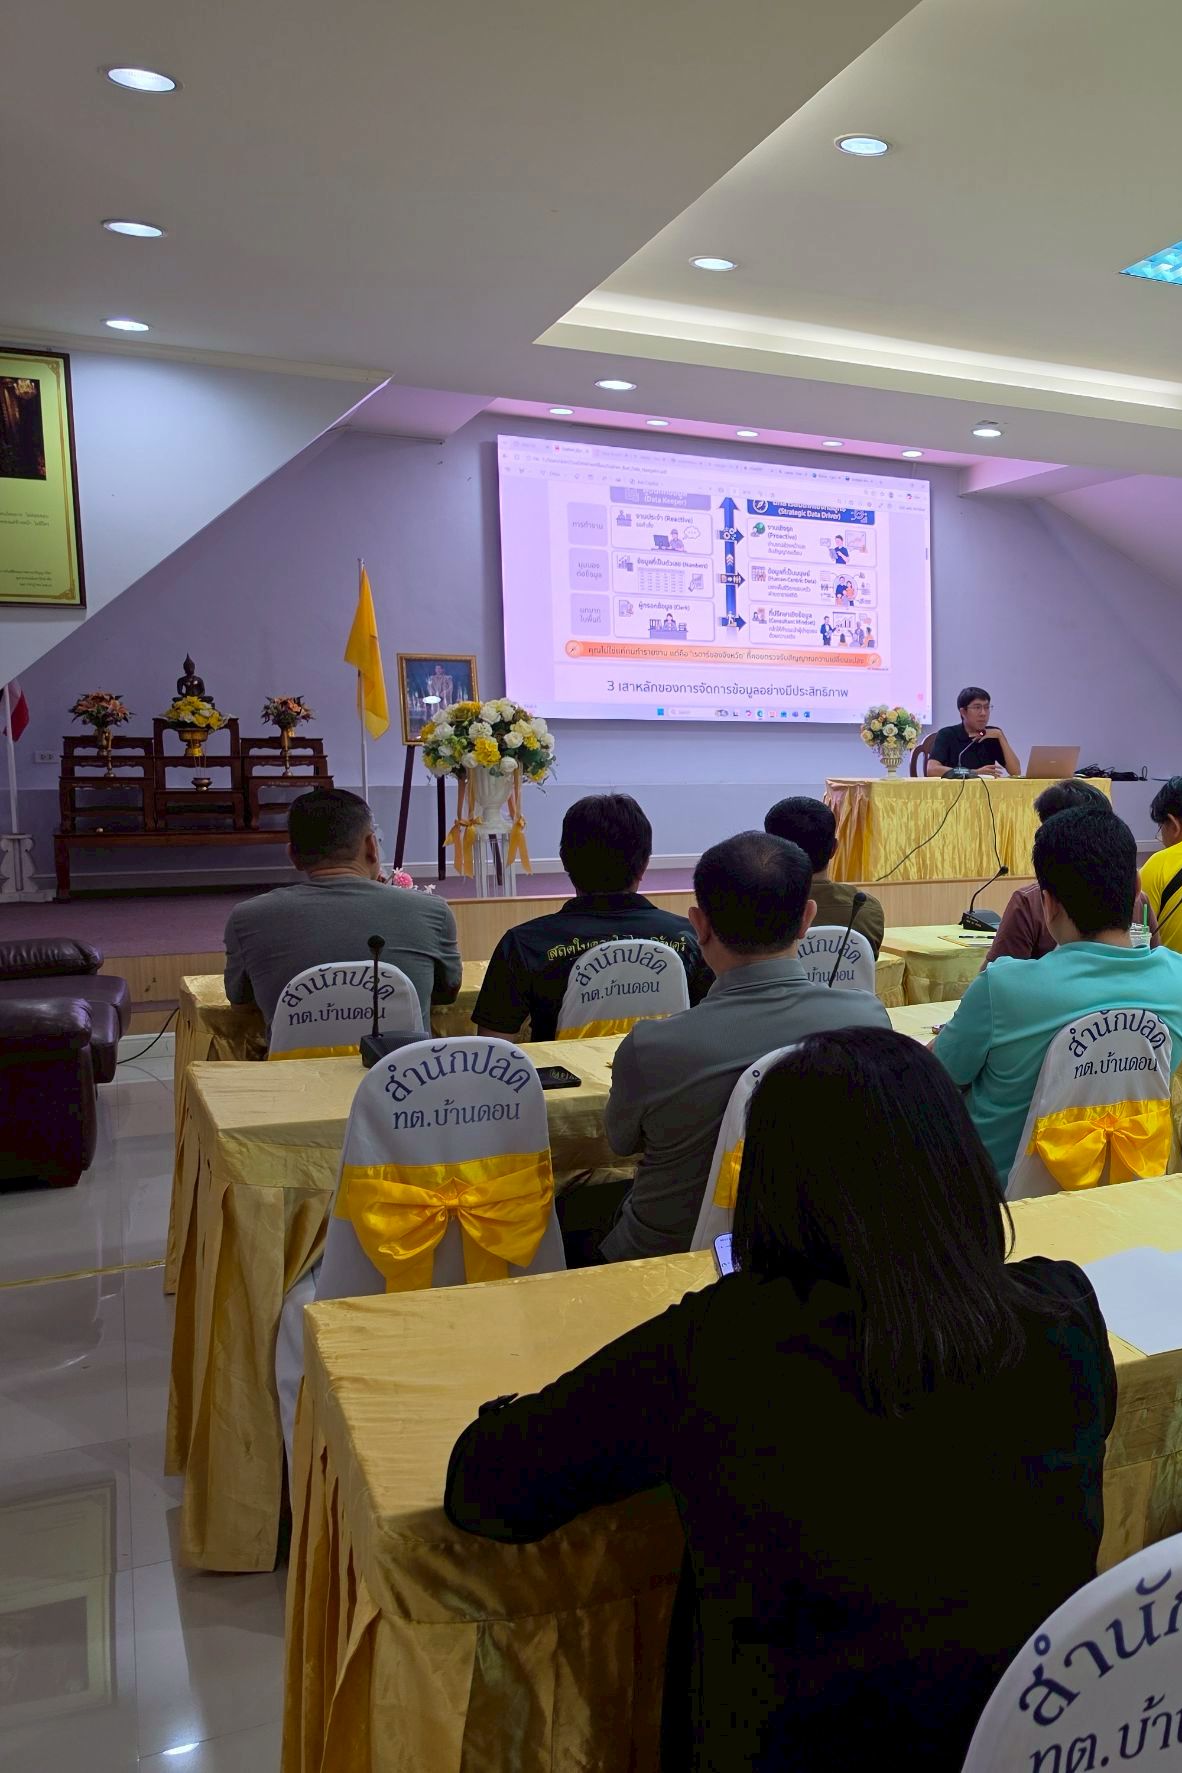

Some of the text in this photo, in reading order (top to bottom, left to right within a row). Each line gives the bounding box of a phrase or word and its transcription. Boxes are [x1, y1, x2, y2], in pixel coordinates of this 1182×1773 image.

[664, 515, 693, 523] (Reactive)
[778, 508, 841, 520] (Strategic Data Driver)
[767, 532, 798, 540] (Proactive)
[607, 679, 849, 699] 3 เสาหลักของการจัดการข้อมูลอย่างมีประสิทธิภาพ
[575, 943, 669, 988] สำนักปลัด
[580, 979, 660, 1004] ทต.บ้านดอน
[385, 1043, 531, 1103] สำนักปลัด
[1073, 1052, 1158, 1080] ทต.บ้านดอน
[393, 1098, 521, 1130] ทต.บ้านดอน
